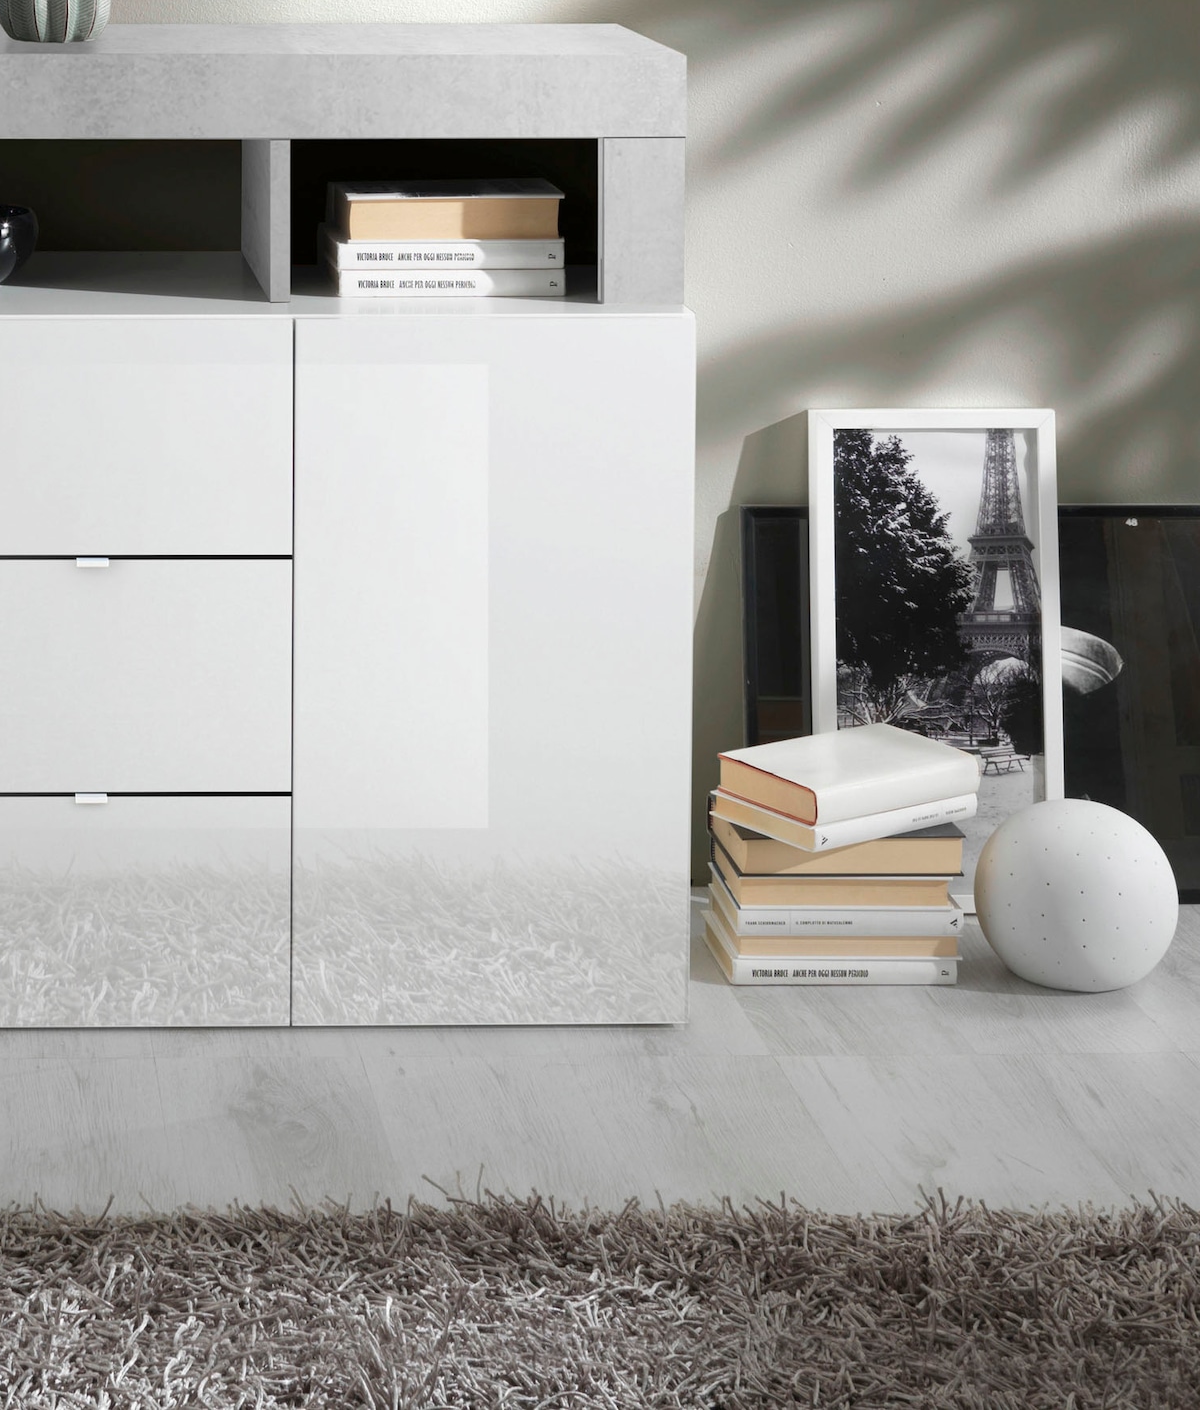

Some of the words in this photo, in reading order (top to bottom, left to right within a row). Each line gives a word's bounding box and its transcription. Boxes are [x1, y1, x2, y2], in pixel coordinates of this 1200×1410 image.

[356, 252, 378, 261] VICTORIA
[379, 252, 393, 261] BRUCE
[397, 252, 412, 261] ANCHE
[413, 252, 422, 261] PER
[423, 252, 435, 261] OGGI
[358, 280, 379, 289] VICTORIA
[380, 280, 395, 289] BRUCE
[414, 280, 424, 289] PER
[425, 280, 436, 289] OGGI
[752, 969, 773, 978] VICTORIA
[774, 969, 788, 978] BRUCE
[792, 969, 807, 978] ANCHE
[808, 969, 817, 978] PER
[818, 969, 830, 978] OGGI
